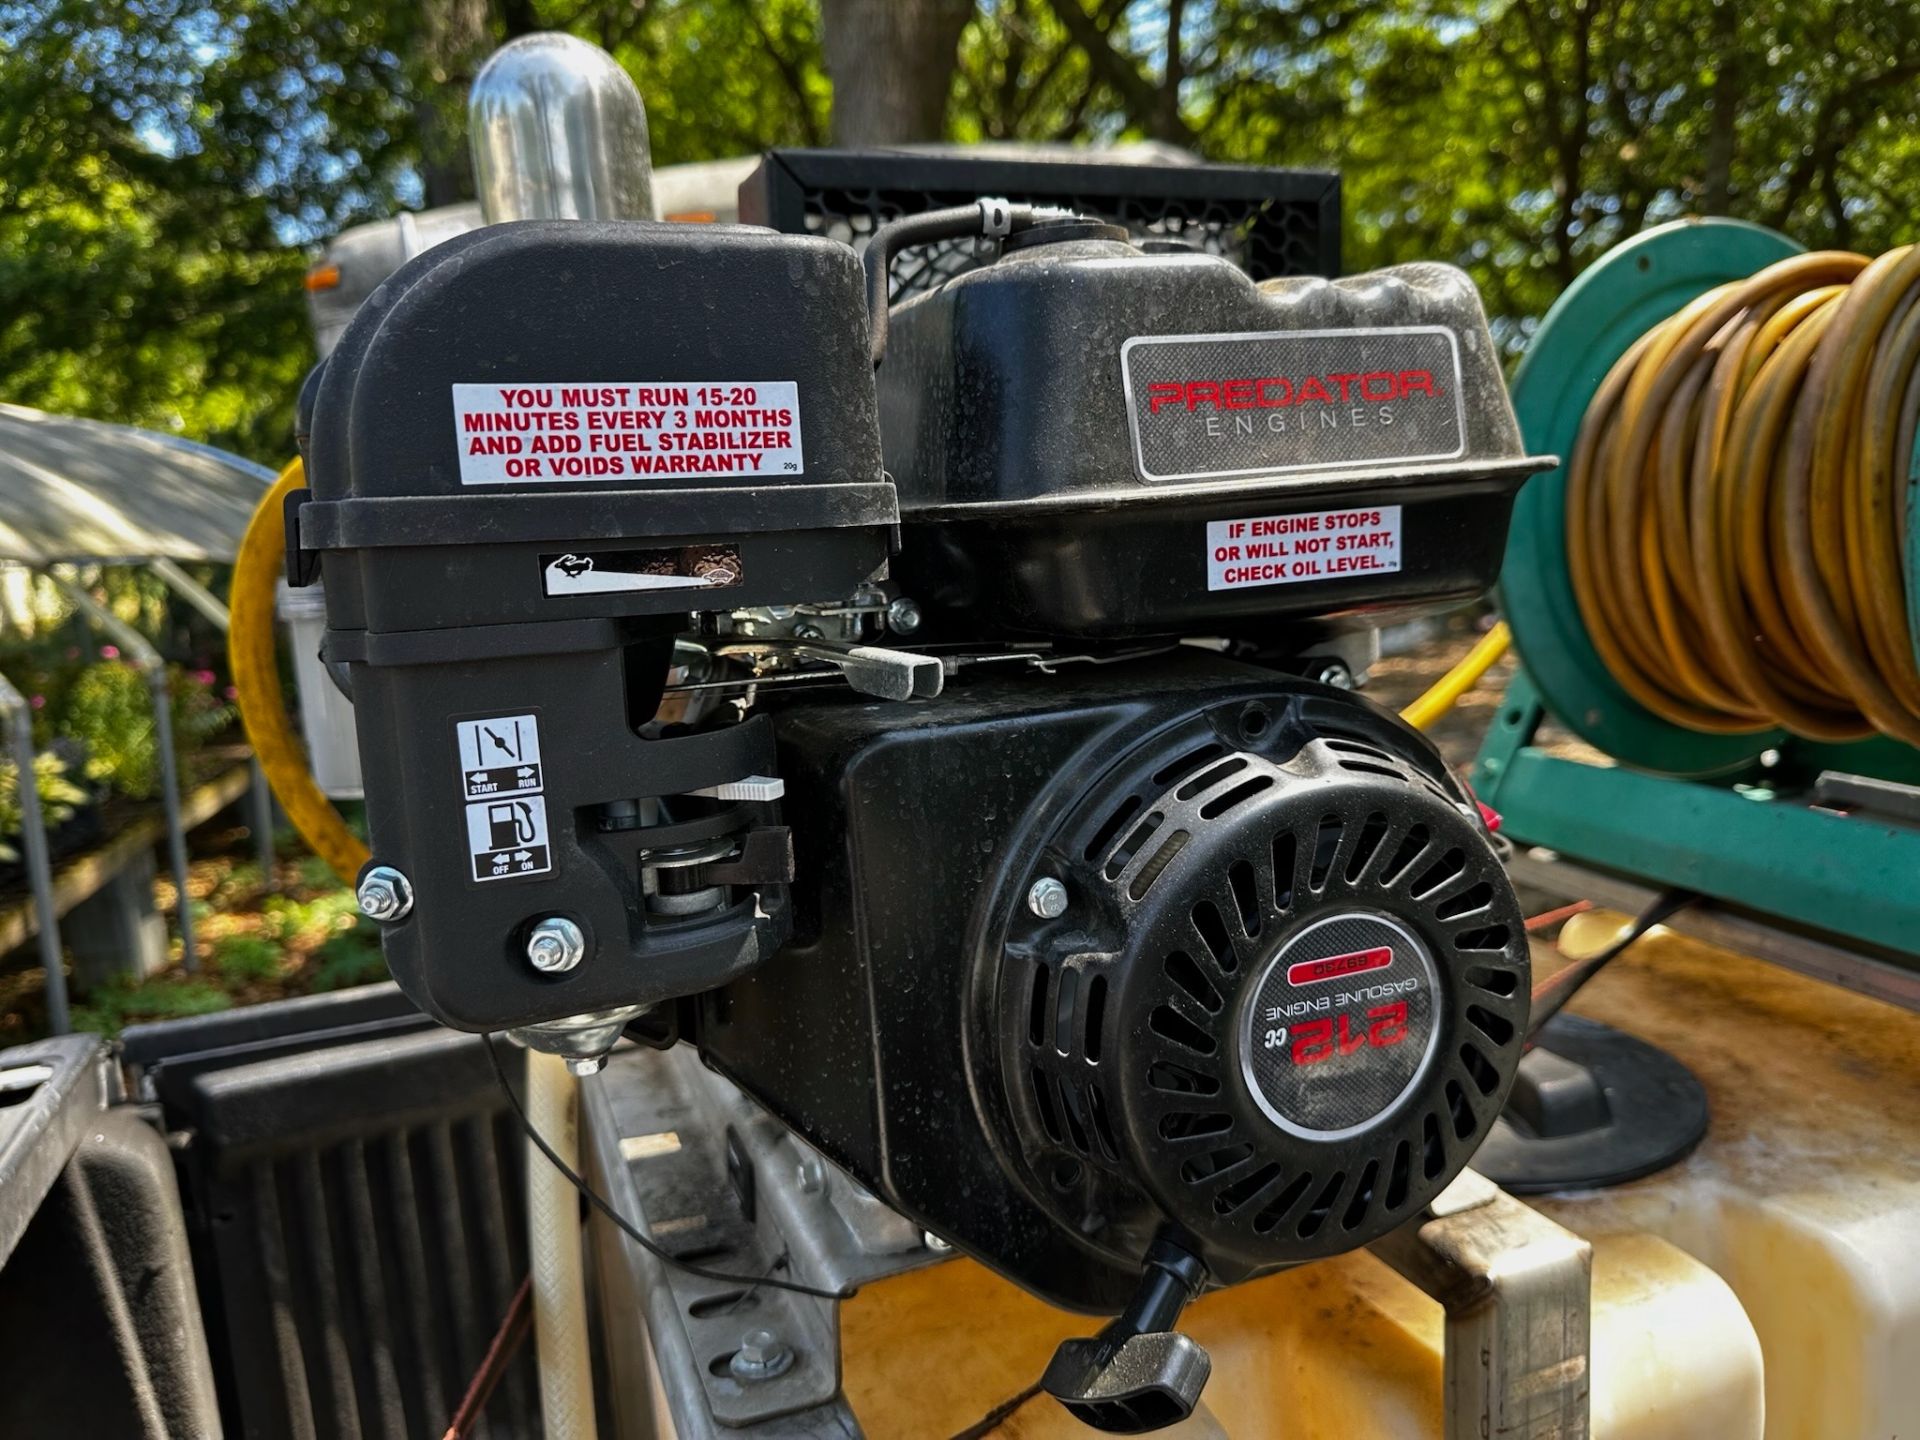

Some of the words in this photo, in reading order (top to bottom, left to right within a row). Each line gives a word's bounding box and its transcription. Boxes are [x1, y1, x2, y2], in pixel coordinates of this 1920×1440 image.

[500, 389, 553, 408] YOU
[562, 388, 630, 407] MUST
[639, 388, 688, 406] RUN
[697, 387, 757, 406] 15-20
[1149, 369, 1434, 414] PREDATOR
[464, 411, 579, 432] MINUTES
[587, 411, 666, 430] EVERY
[674, 410, 687, 428] 3
[694, 409, 792, 428] MONTHS
[1206, 406, 1394, 436] ENGINES
[469, 435, 523, 455] AND
[531, 435, 582, 454] ADD
[589, 434, 652, 452] FUEL
[658, 431, 792, 450] STABILIZER
[505, 458, 542, 477] OR
[548, 456, 624, 476] VOIDS
[631, 453, 763, 473] WARRANTY
[783, 462, 798, 471] 20g
[1229, 523, 1246, 538] IF
[1251, 517, 1319, 537] ENGINE
[1325, 511, 1381, 530] STOPS
[1215, 546, 1241, 562] OR
[1245, 542, 1289, 559] WILL
[1295, 538, 1331, 554] NOT
[1336, 532, 1393, 550] START,
[1224, 563, 1287, 583] CHECK
[1292, 560, 1321, 577] OIL
[1327, 555, 1385, 573] LEVEL.
[471, 783, 498, 794] START
[519, 778, 537, 788] RUN
[493, 865, 509, 875] OFF
[521, 861, 534, 871] ON
[1335, 977, 1418, 1006] GASOLINE
[1265, 997, 1330, 1021] ENGINE
[1288, 1000, 1409, 1066] 212
